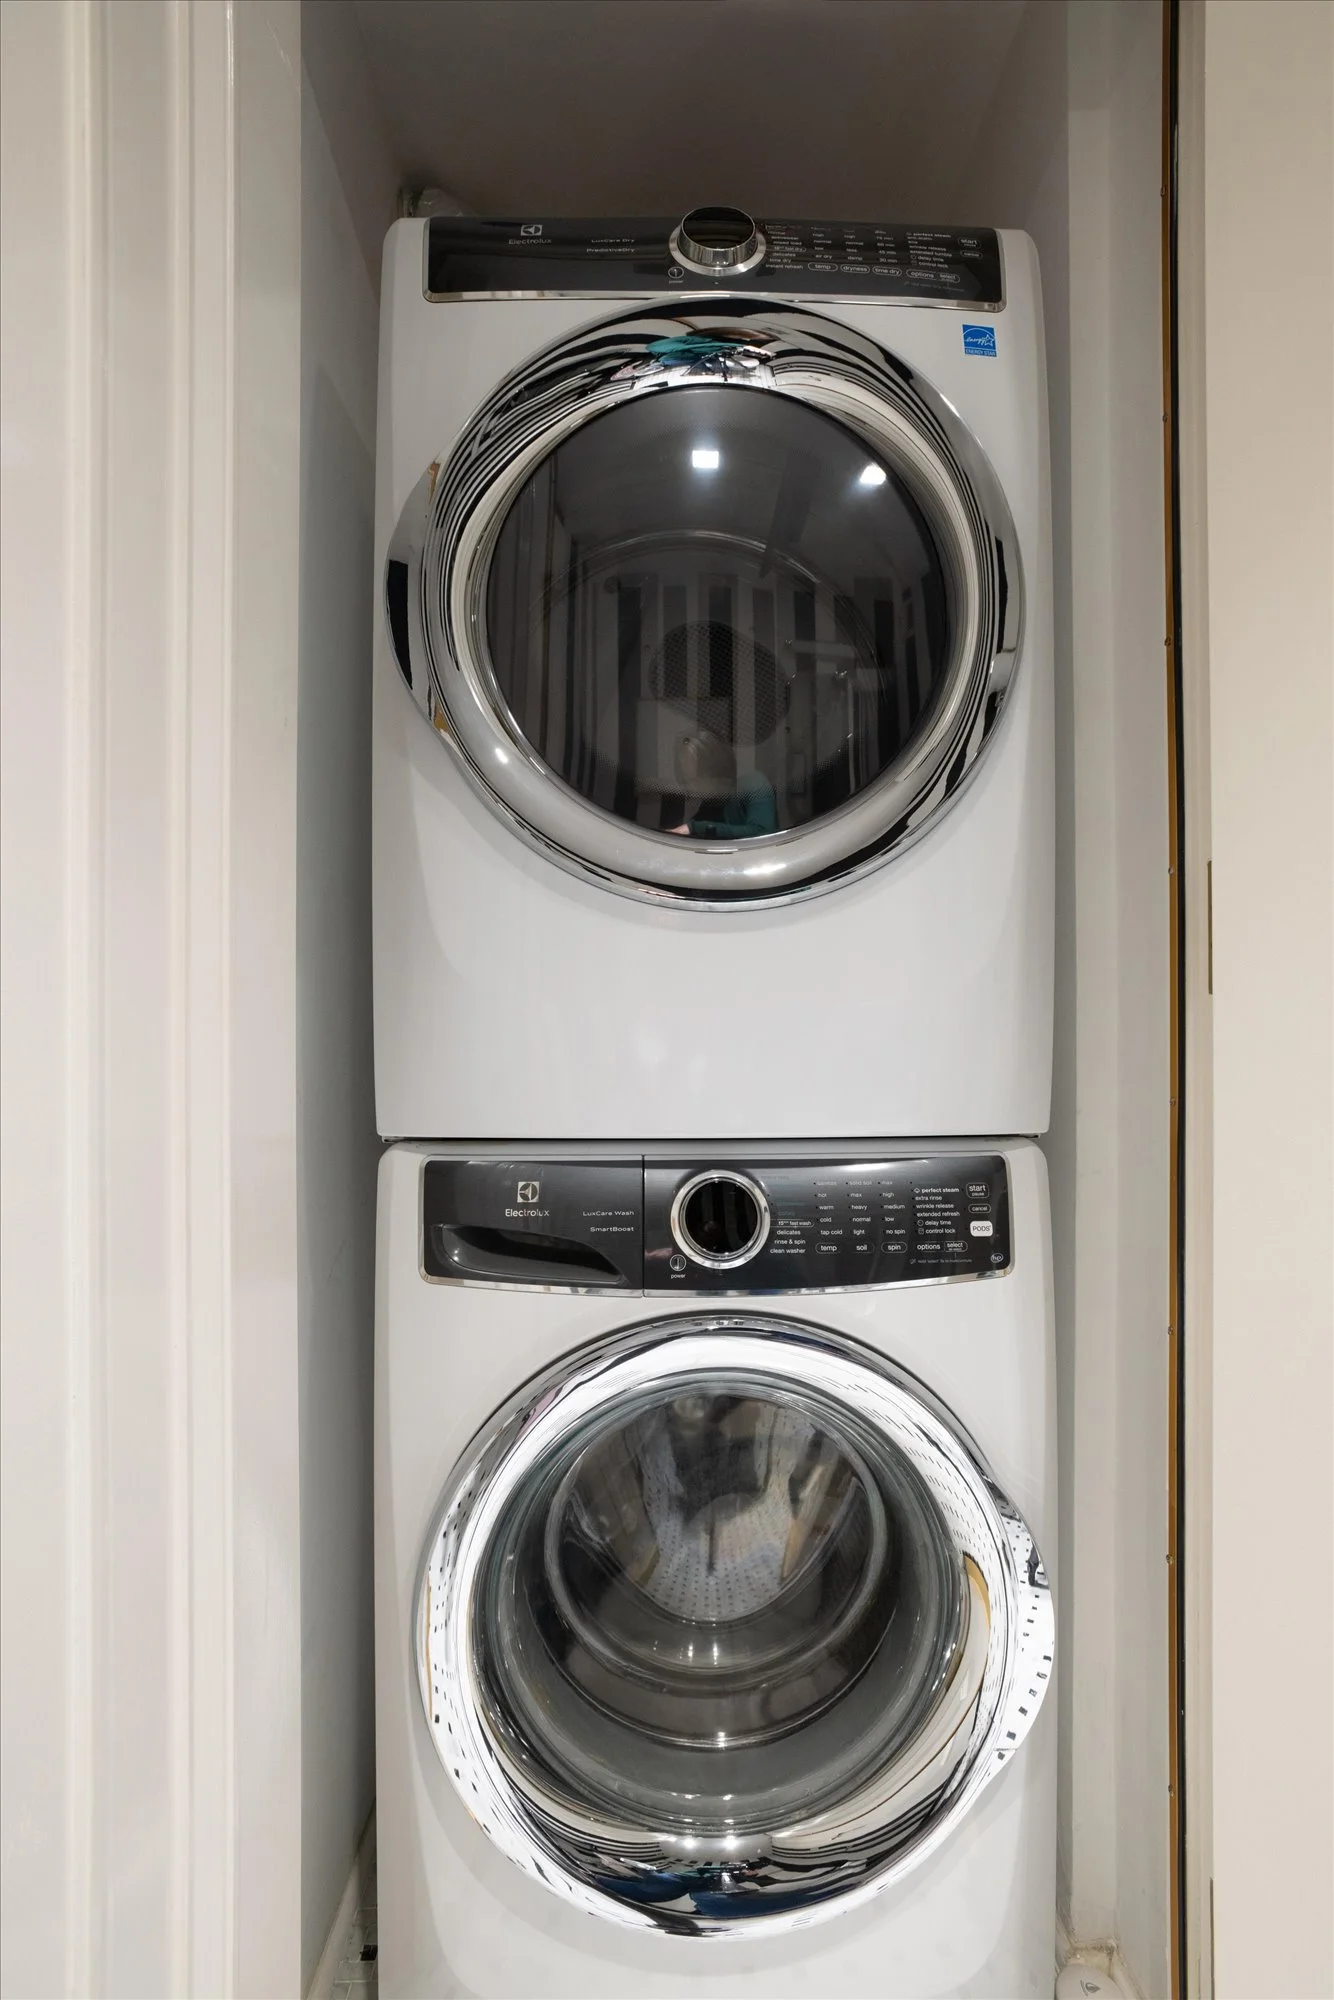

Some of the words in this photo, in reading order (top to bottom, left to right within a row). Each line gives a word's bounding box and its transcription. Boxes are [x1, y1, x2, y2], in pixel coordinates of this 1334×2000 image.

[505, 1209, 550, 1217] Electrolux
[820, 1244, 837, 1253] temp
[887, 1244, 901, 1252] spin
[917, 1243, 941, 1251] options
